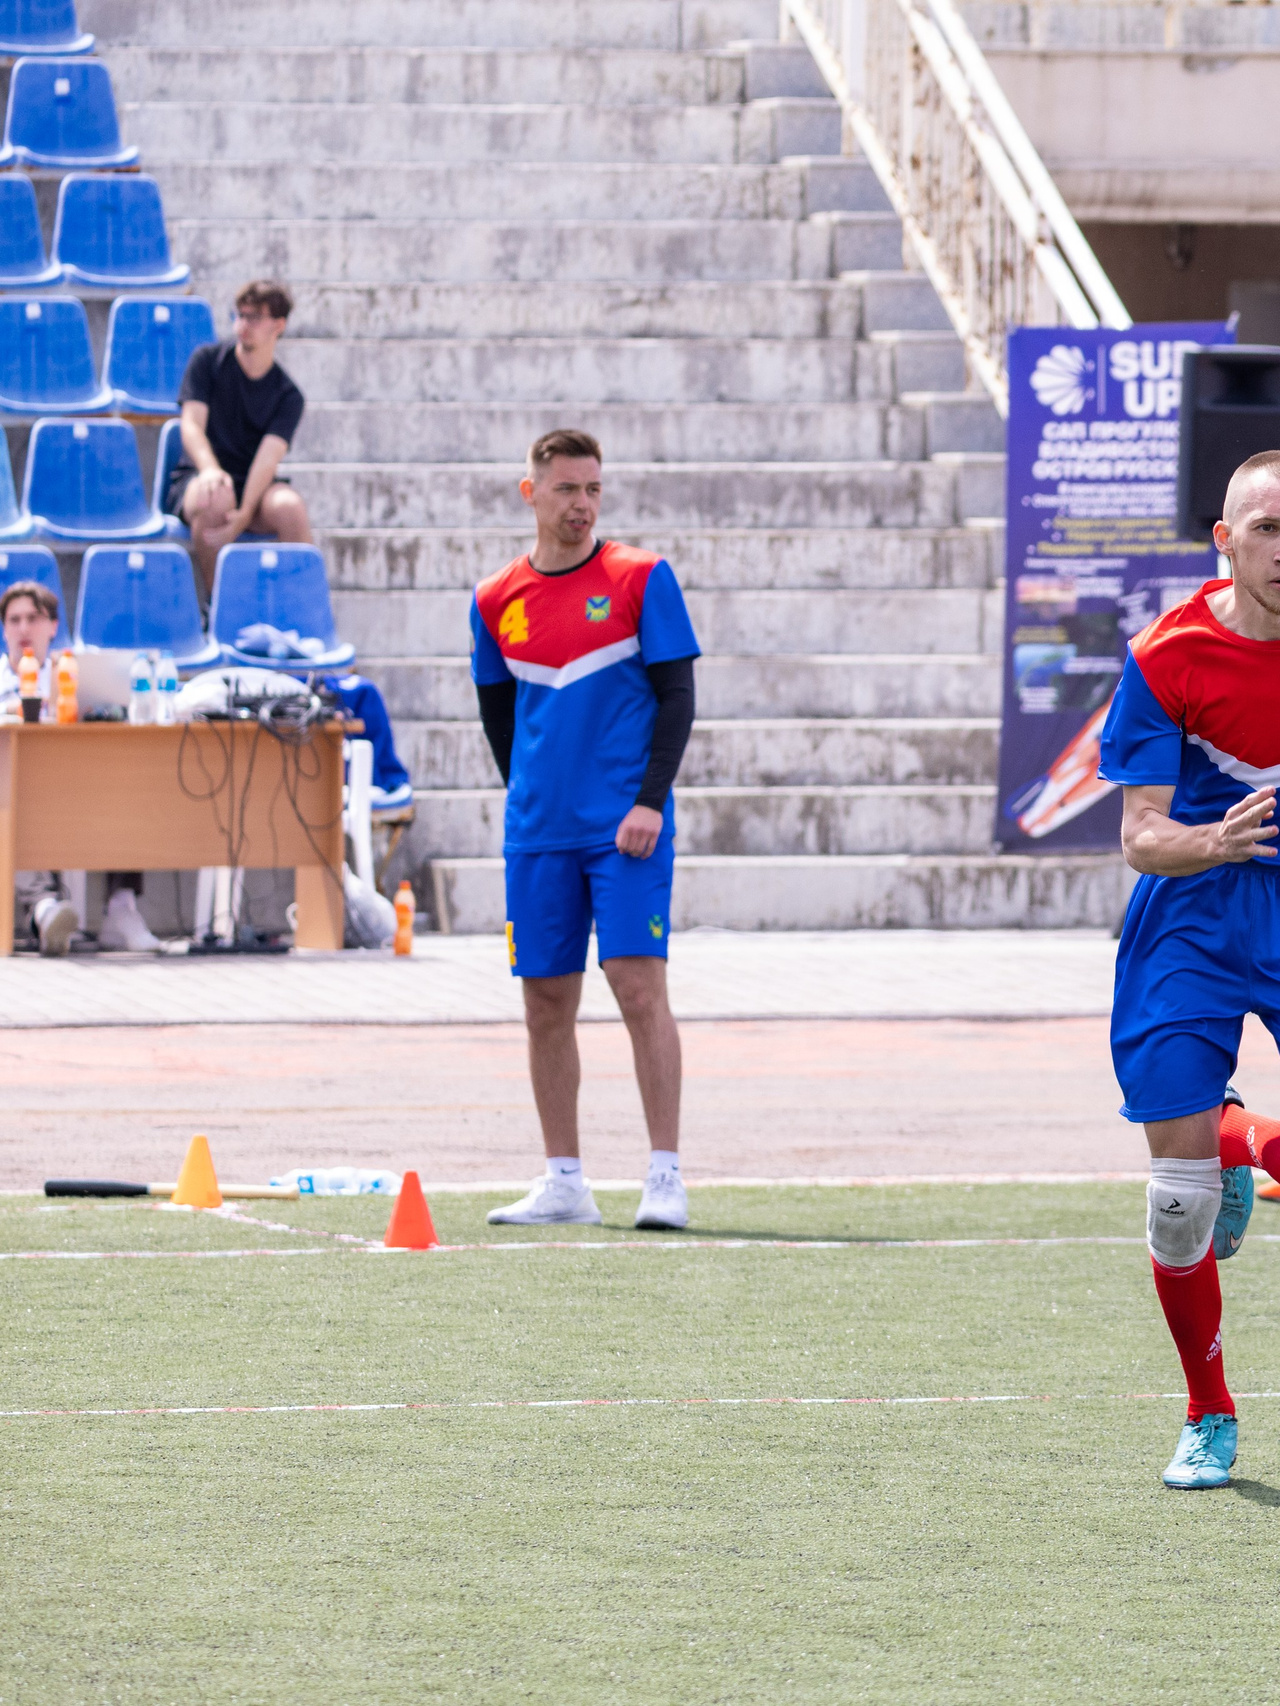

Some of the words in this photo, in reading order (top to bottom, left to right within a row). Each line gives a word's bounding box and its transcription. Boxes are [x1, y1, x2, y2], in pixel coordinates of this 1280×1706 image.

[1124, 380, 1182, 418] UP
[1042, 421, 1087, 440] САП
[1032, 459, 1112, 480] ОСТРОВ
[499, 598, 529, 645] 4
